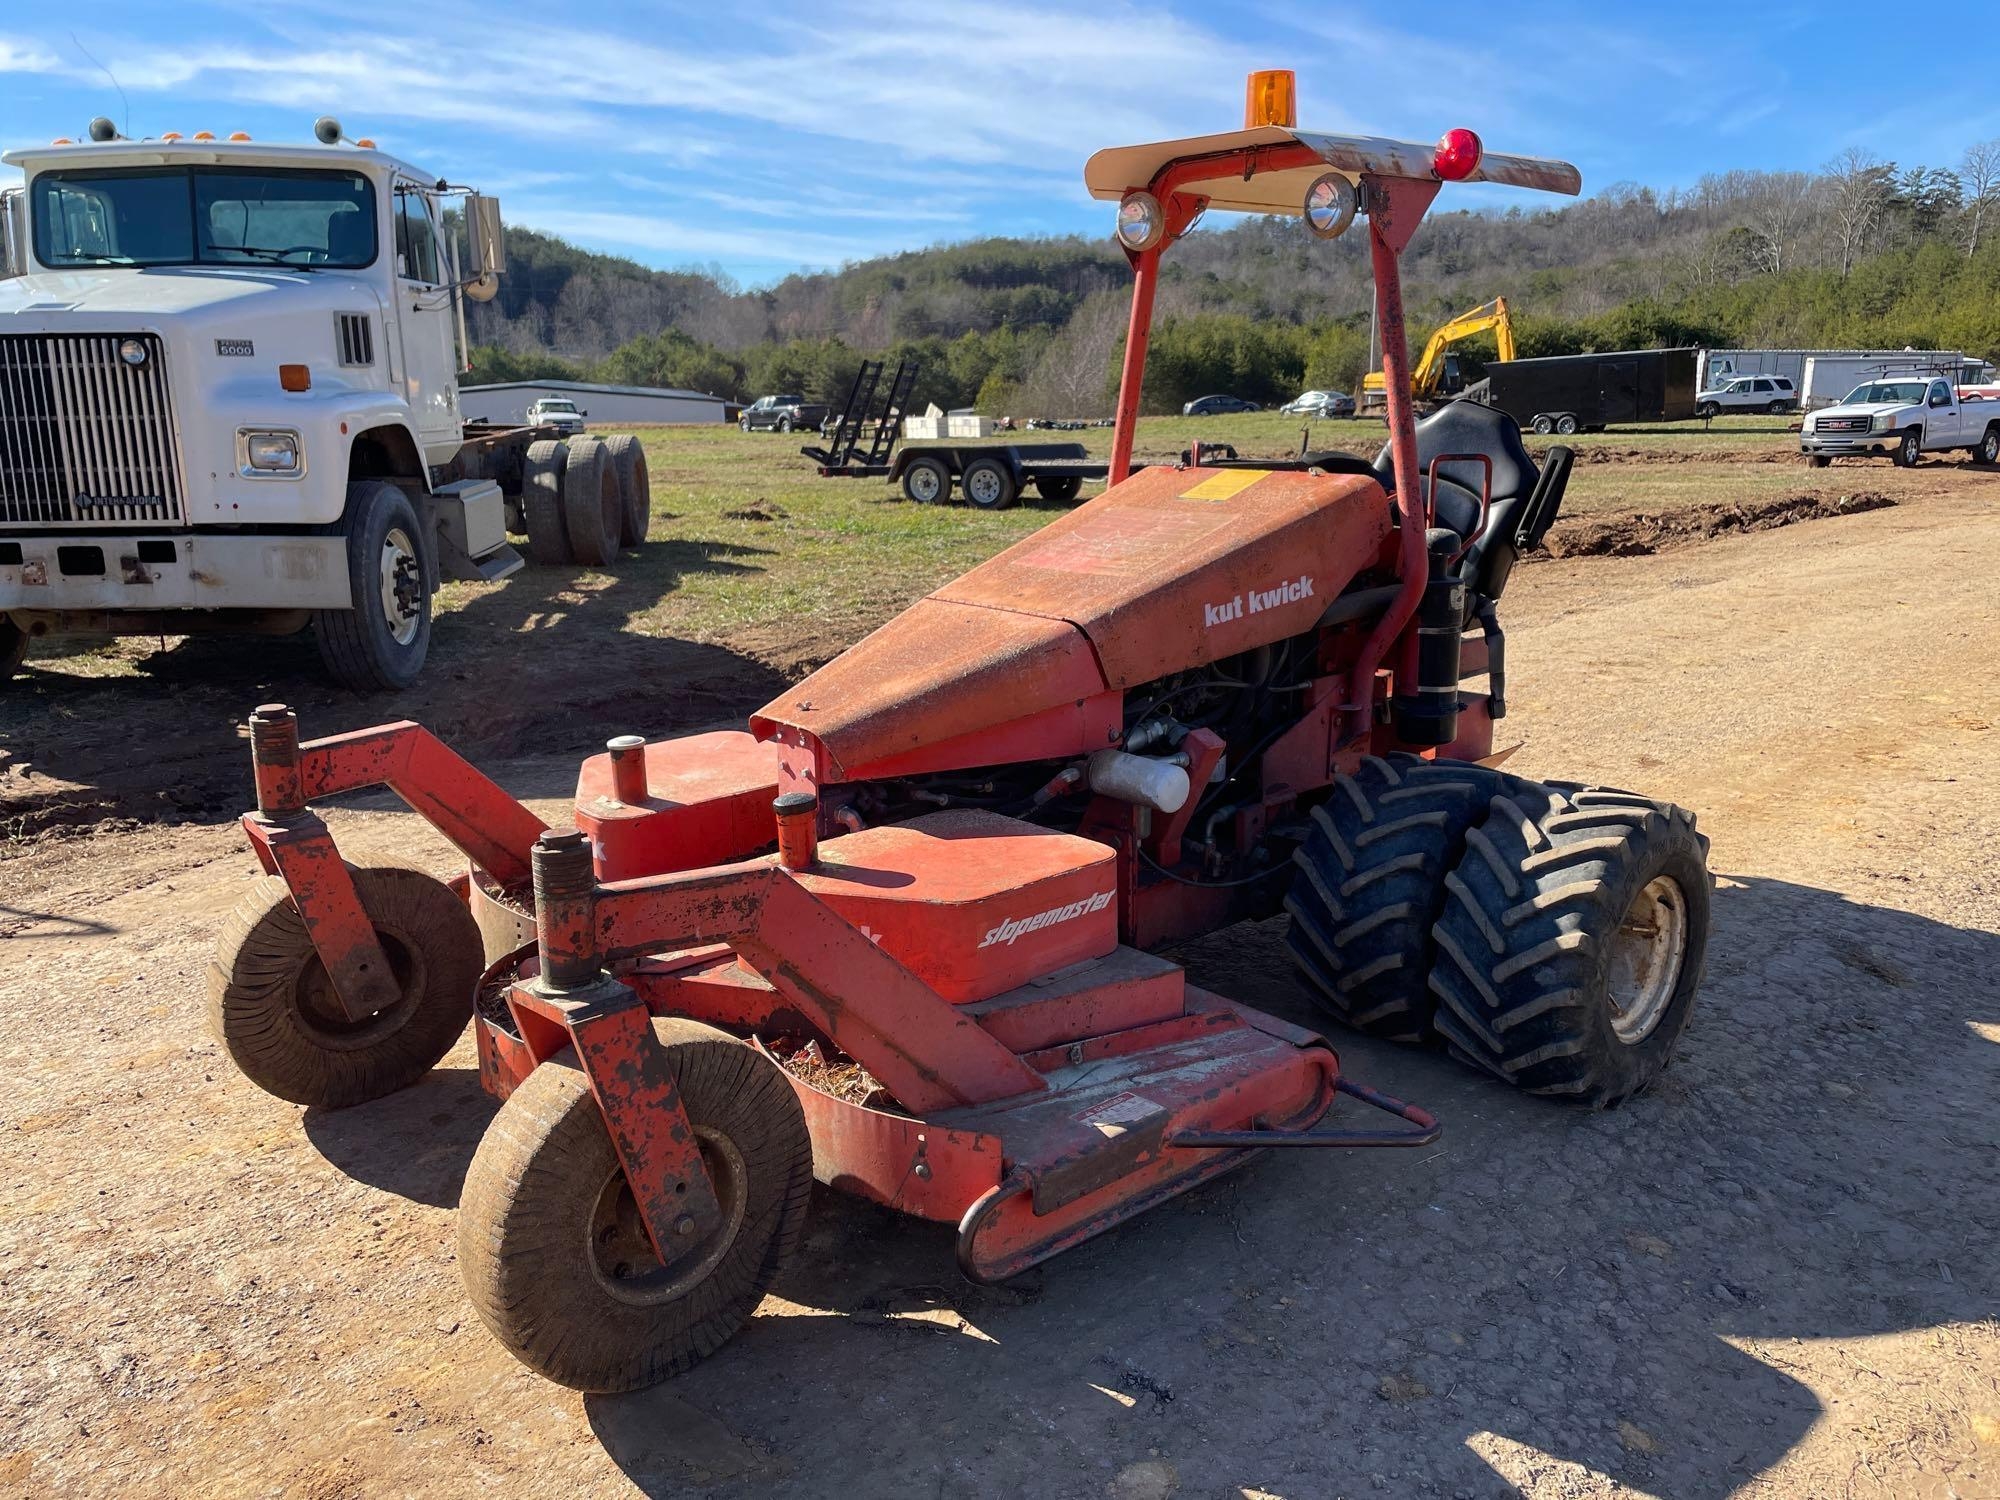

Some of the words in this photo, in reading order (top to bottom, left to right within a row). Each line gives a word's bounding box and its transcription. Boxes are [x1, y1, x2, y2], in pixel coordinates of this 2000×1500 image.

[221, 345, 252, 355] 5000
[1204, 594, 1244, 628] kut
[1248, 575, 1315, 614] kwick
[977, 889, 1116, 948] slopemaster
